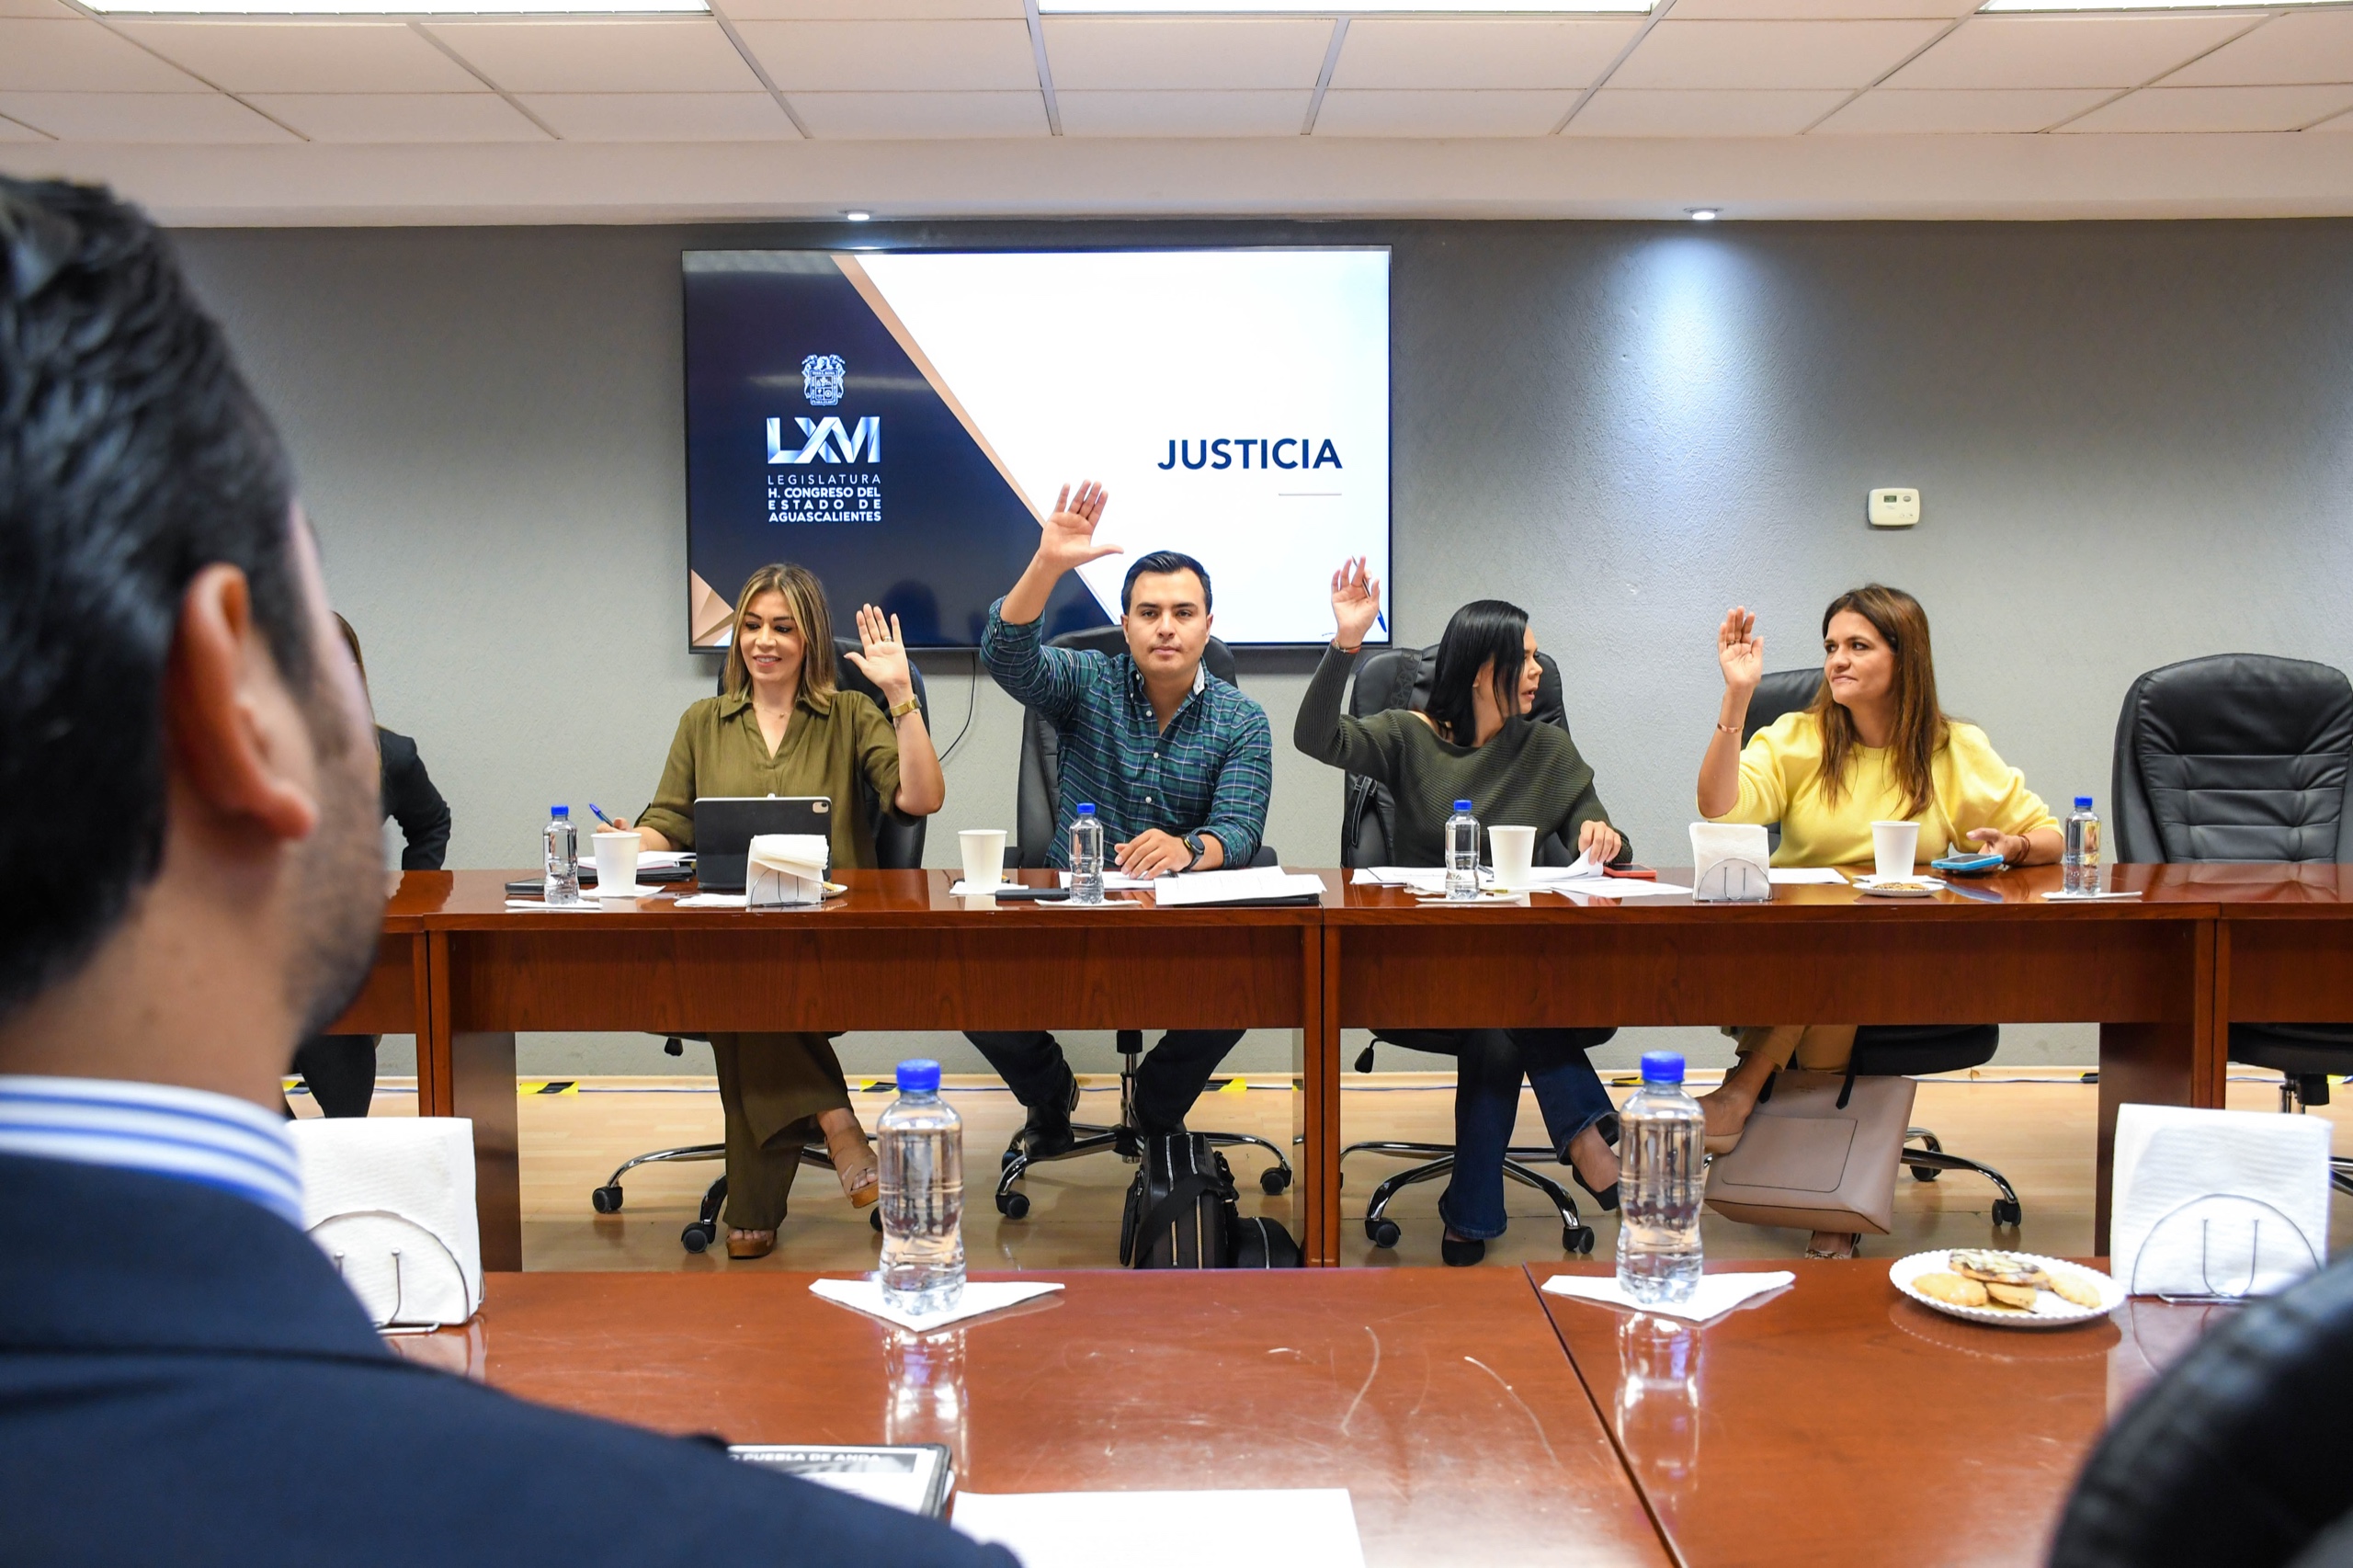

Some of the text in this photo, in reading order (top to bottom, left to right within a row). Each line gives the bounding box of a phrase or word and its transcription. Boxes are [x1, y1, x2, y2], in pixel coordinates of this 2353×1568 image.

[1157, 437, 1343, 470] JUSTICIA
[767, 473, 881, 485] LEGISLATURA
[768, 486, 881, 498] H. CONGRESO DEL
[768, 499, 881, 510] ESTADO DE
[768, 511, 881, 522] AGUASCALIENTES
[743, 1452, 806, 1461] PUEBLA
[809, 1452, 831, 1461] DE
